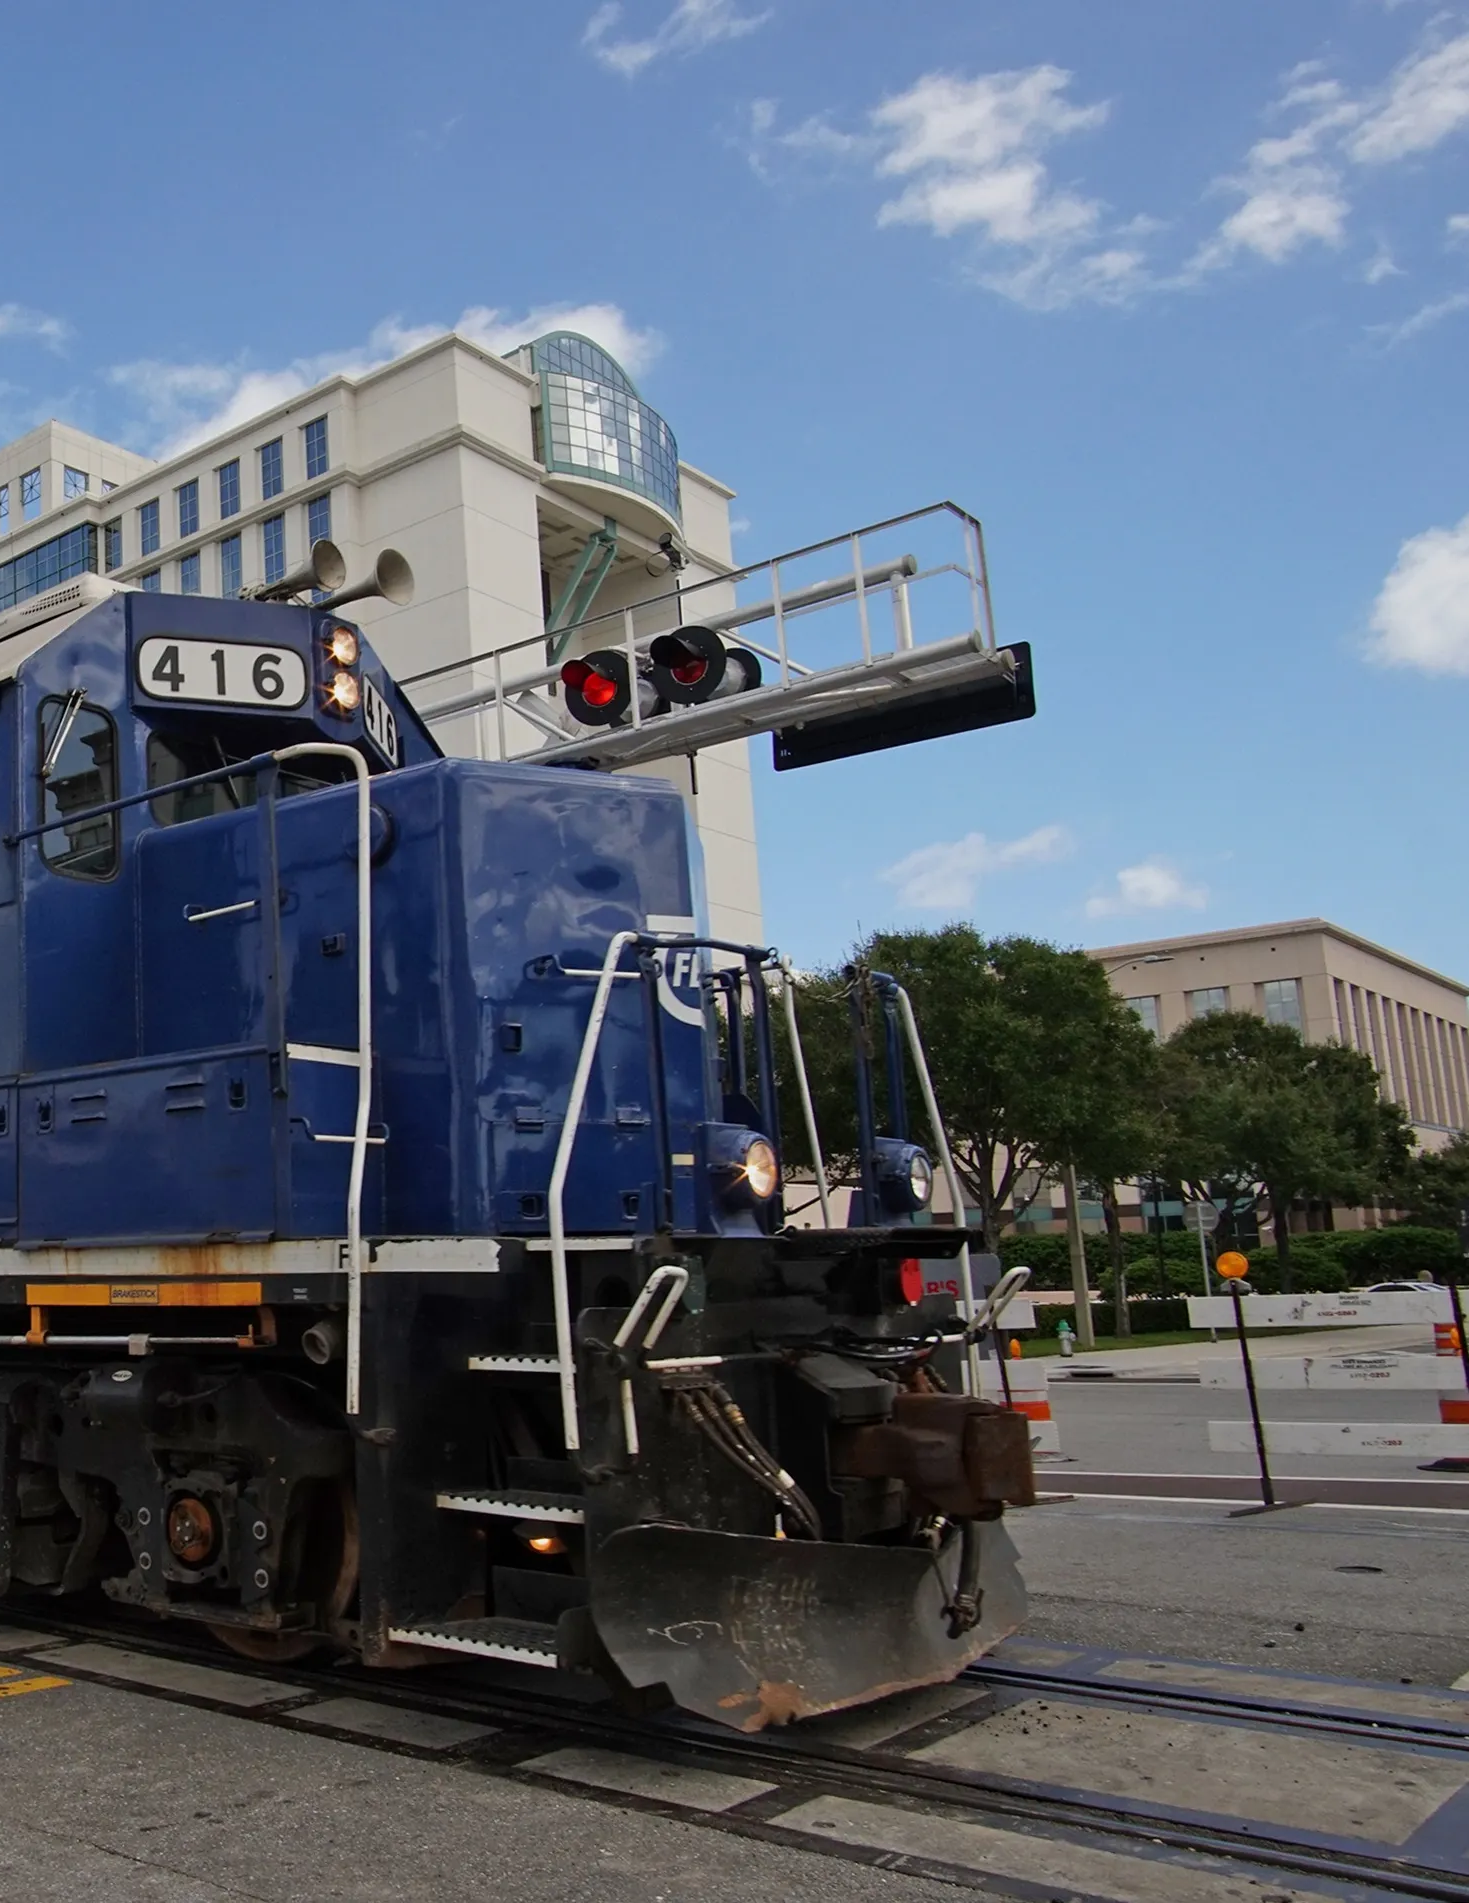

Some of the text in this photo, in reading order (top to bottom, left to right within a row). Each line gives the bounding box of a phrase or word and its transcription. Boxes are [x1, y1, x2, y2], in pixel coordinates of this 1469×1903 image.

[151, 644, 285, 700] 416
[365, 684, 397, 756] 416
[111, 1289, 157, 1299] BRAKESTICK
